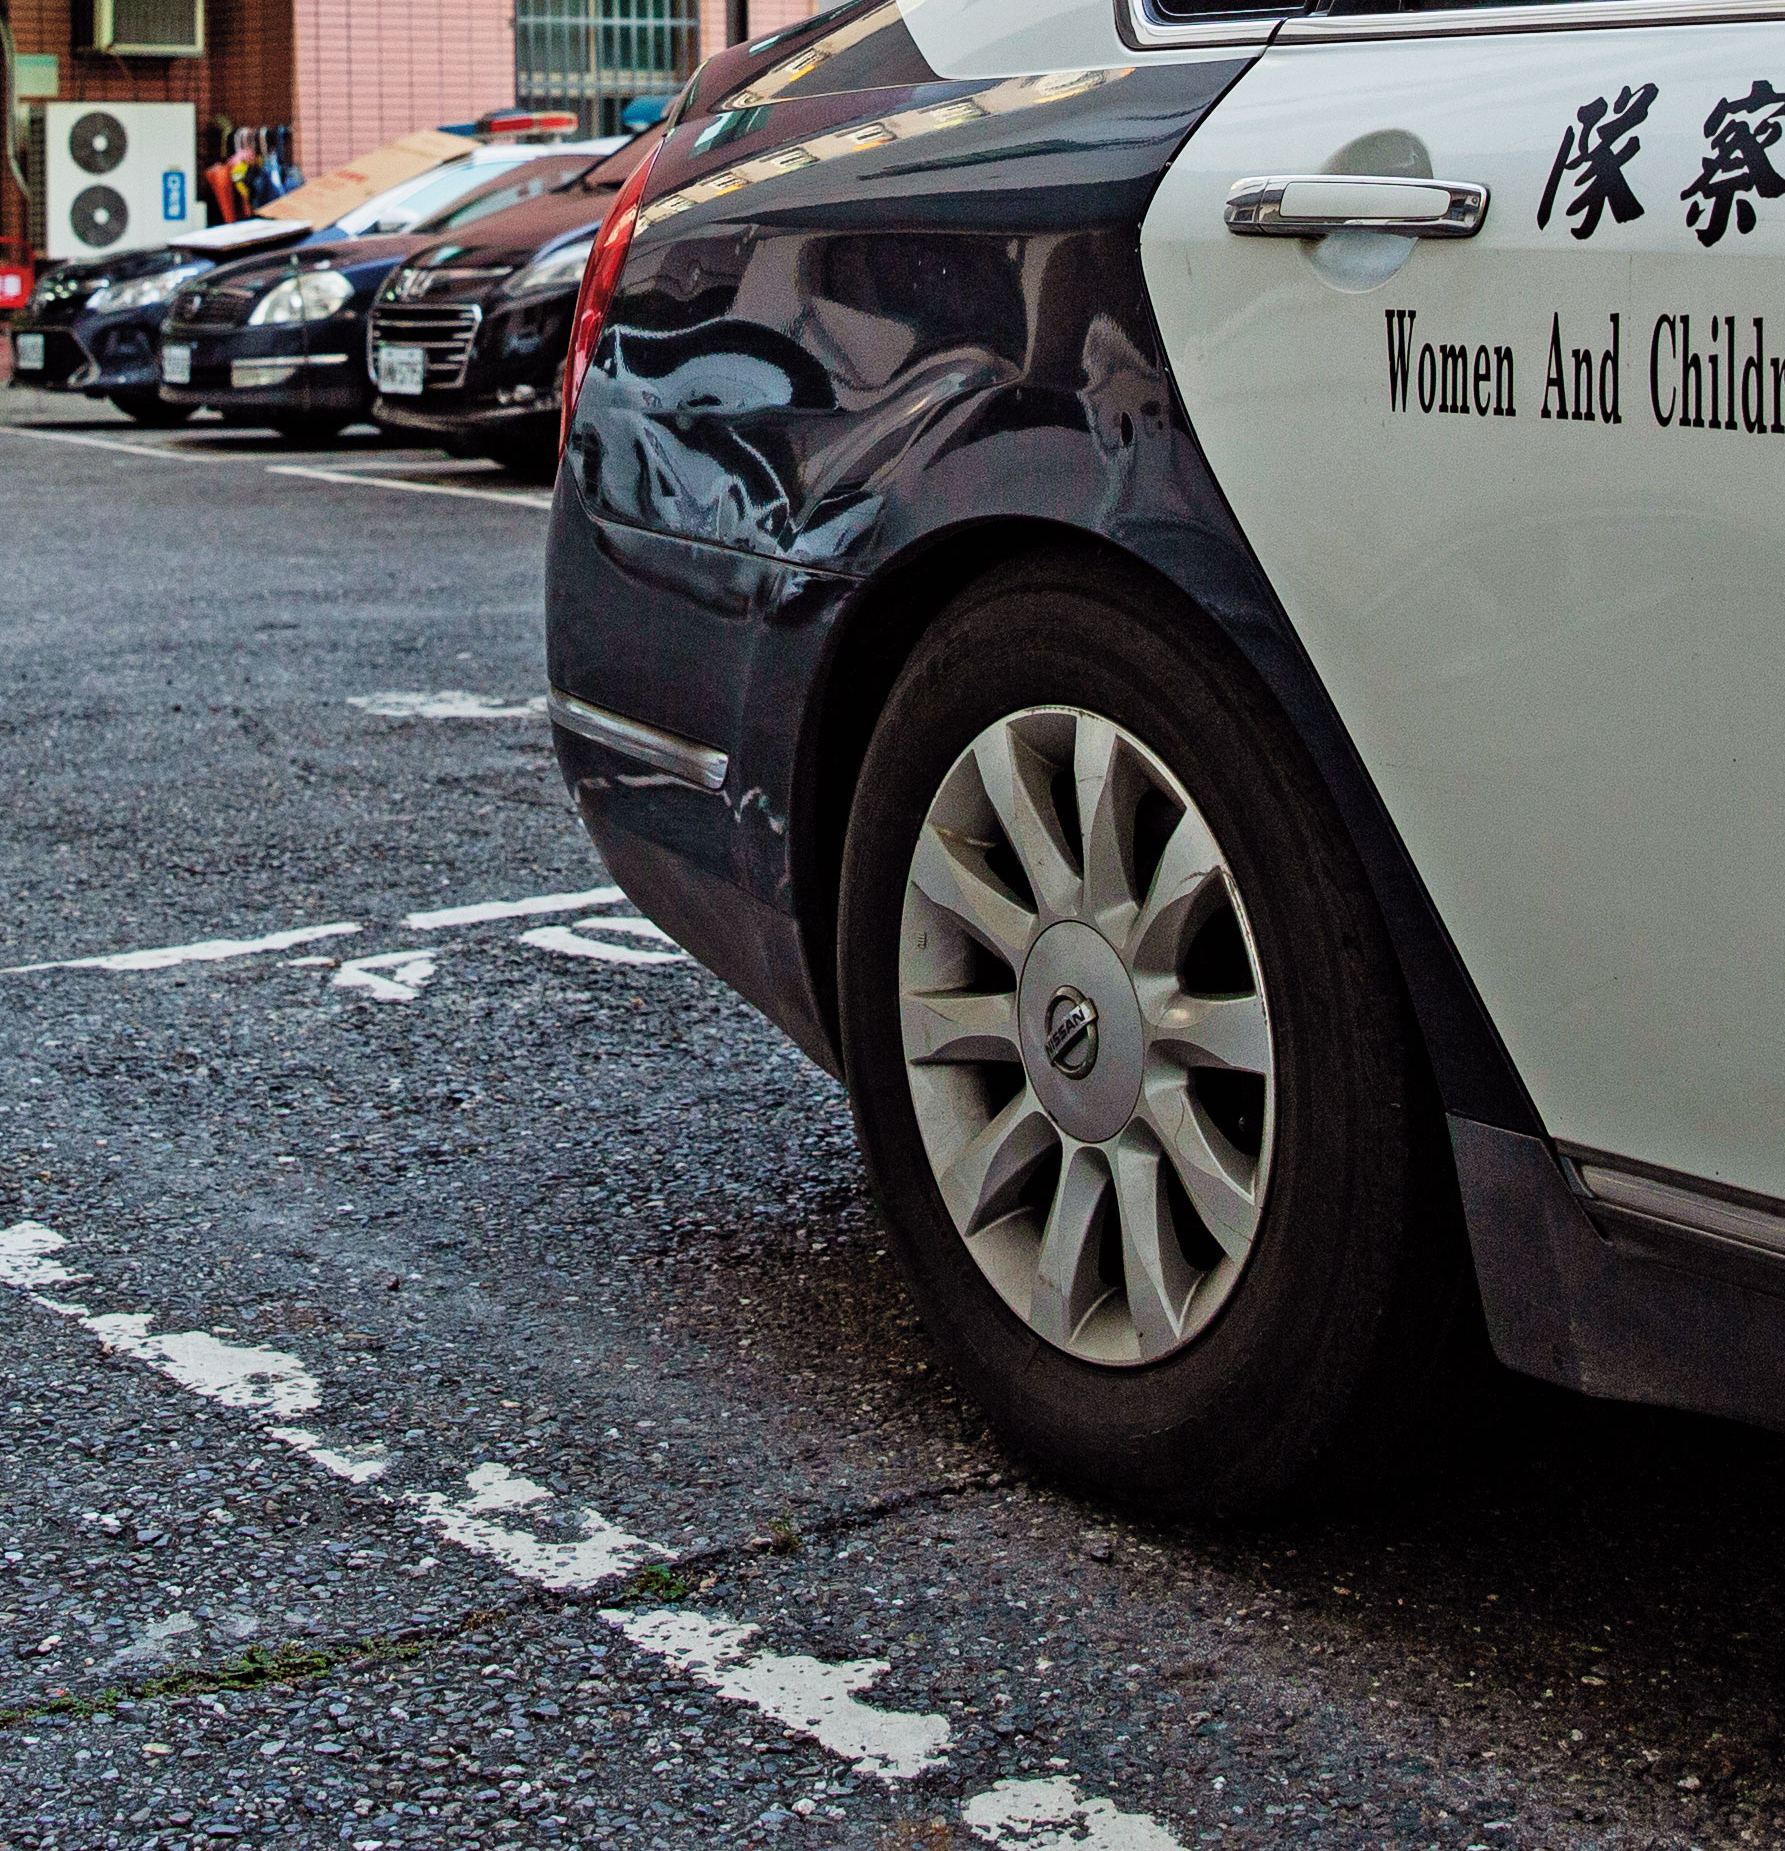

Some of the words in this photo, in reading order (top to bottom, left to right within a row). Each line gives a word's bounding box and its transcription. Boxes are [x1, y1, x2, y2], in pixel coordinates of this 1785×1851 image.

[1384, 309, 1517, 417] Women
[1540, 311, 1622, 425] And
[1045, 1008, 1086, 1059] NISSAN
